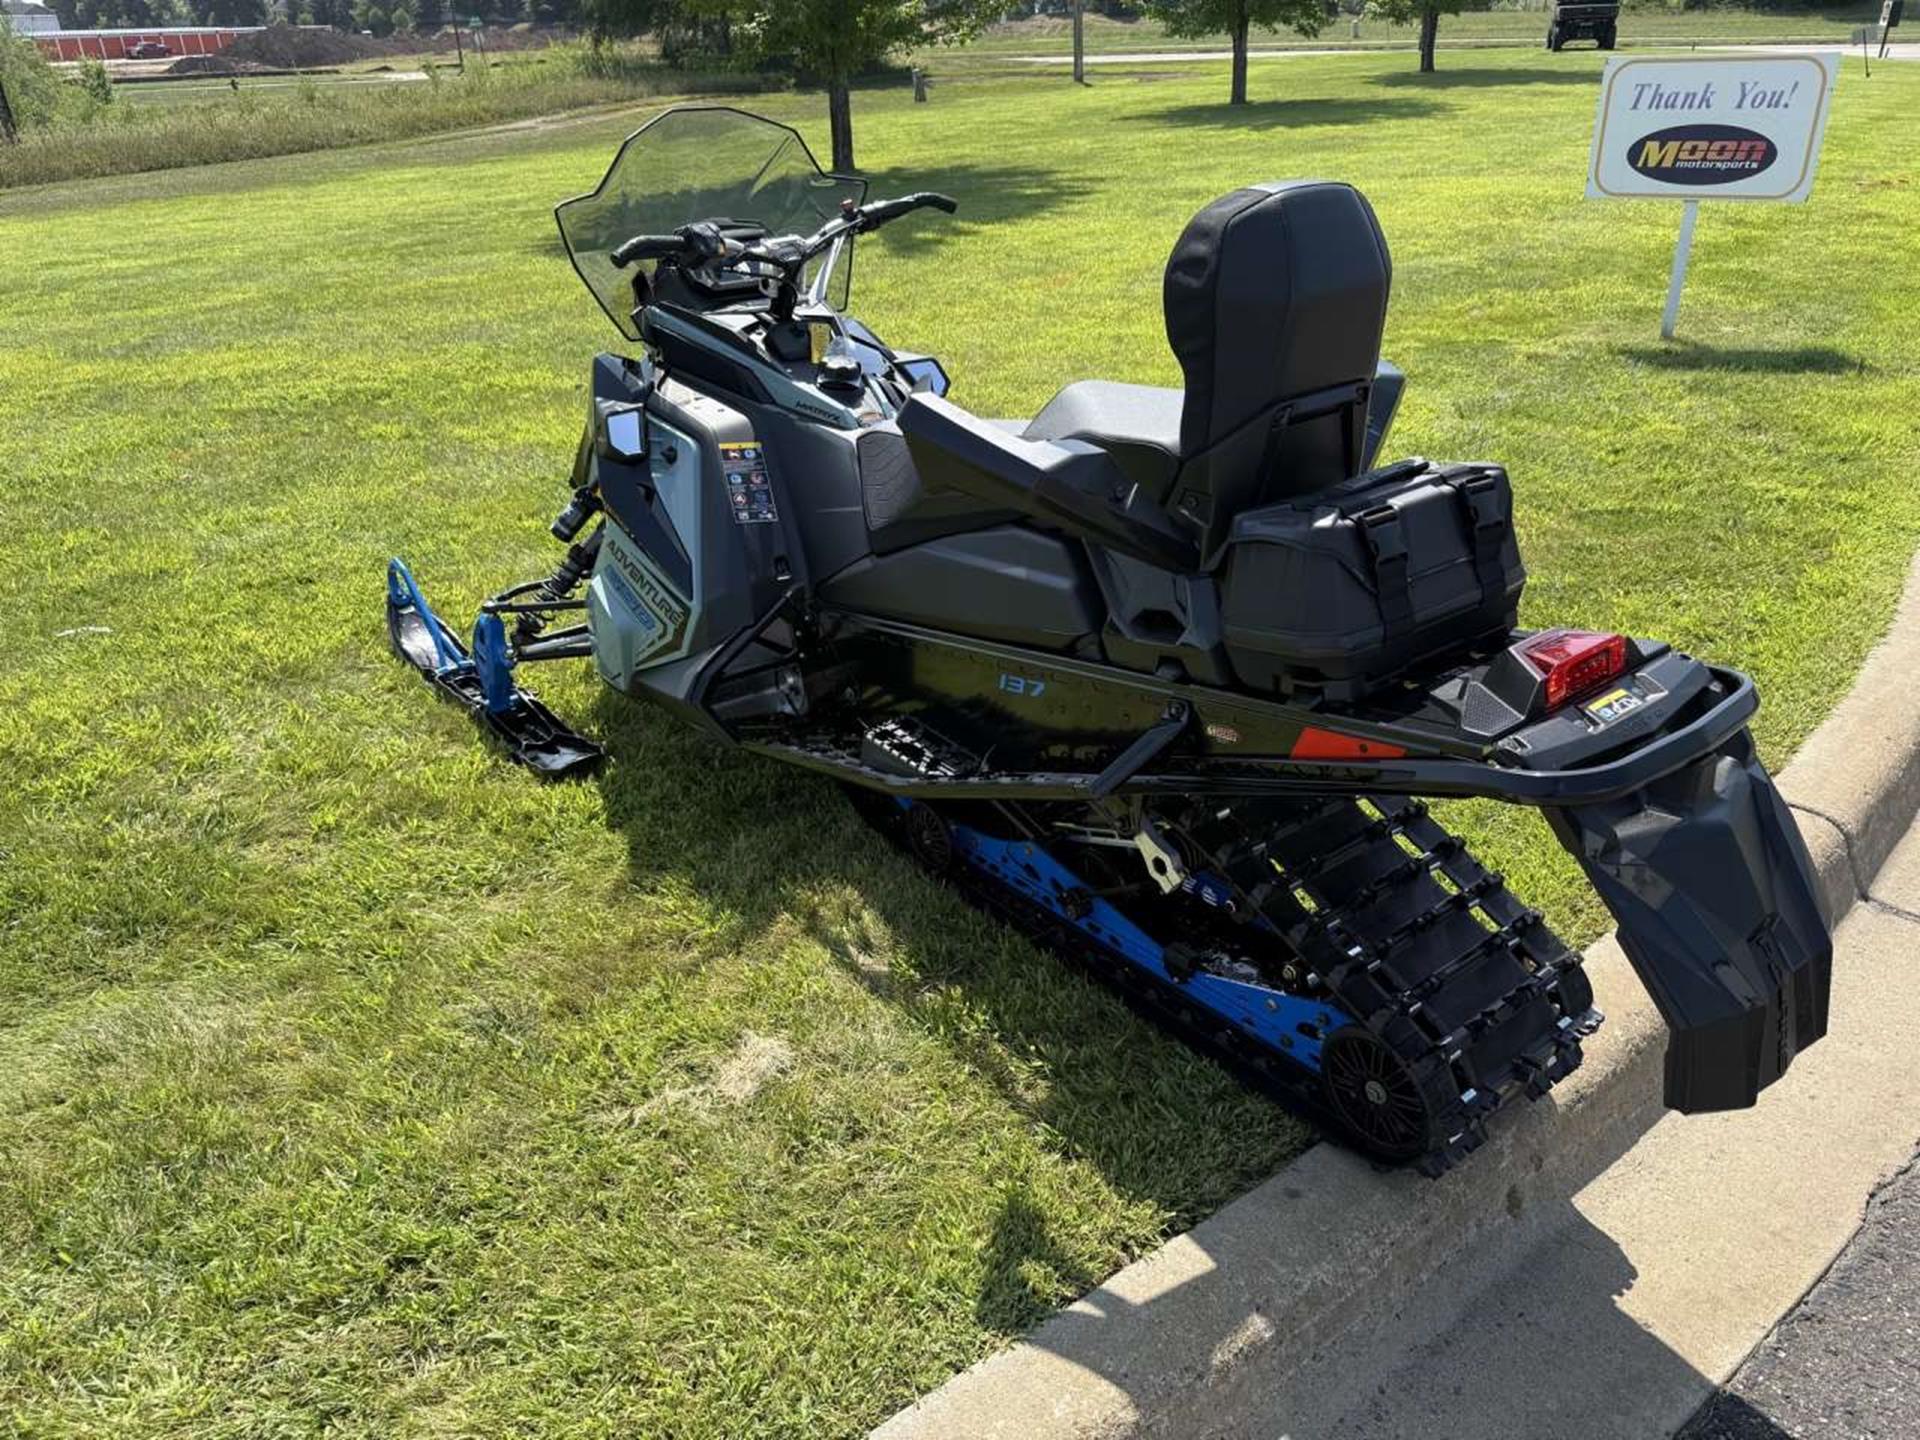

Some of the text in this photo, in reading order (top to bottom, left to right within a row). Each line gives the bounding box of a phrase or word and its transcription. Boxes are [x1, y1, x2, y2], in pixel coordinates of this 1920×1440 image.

[1629, 80, 1800, 111] Thank You!
[1674, 159, 1759, 171] motorsports
[606, 540, 685, 626] ADVENTURE
[999, 673, 1045, 697] 137
